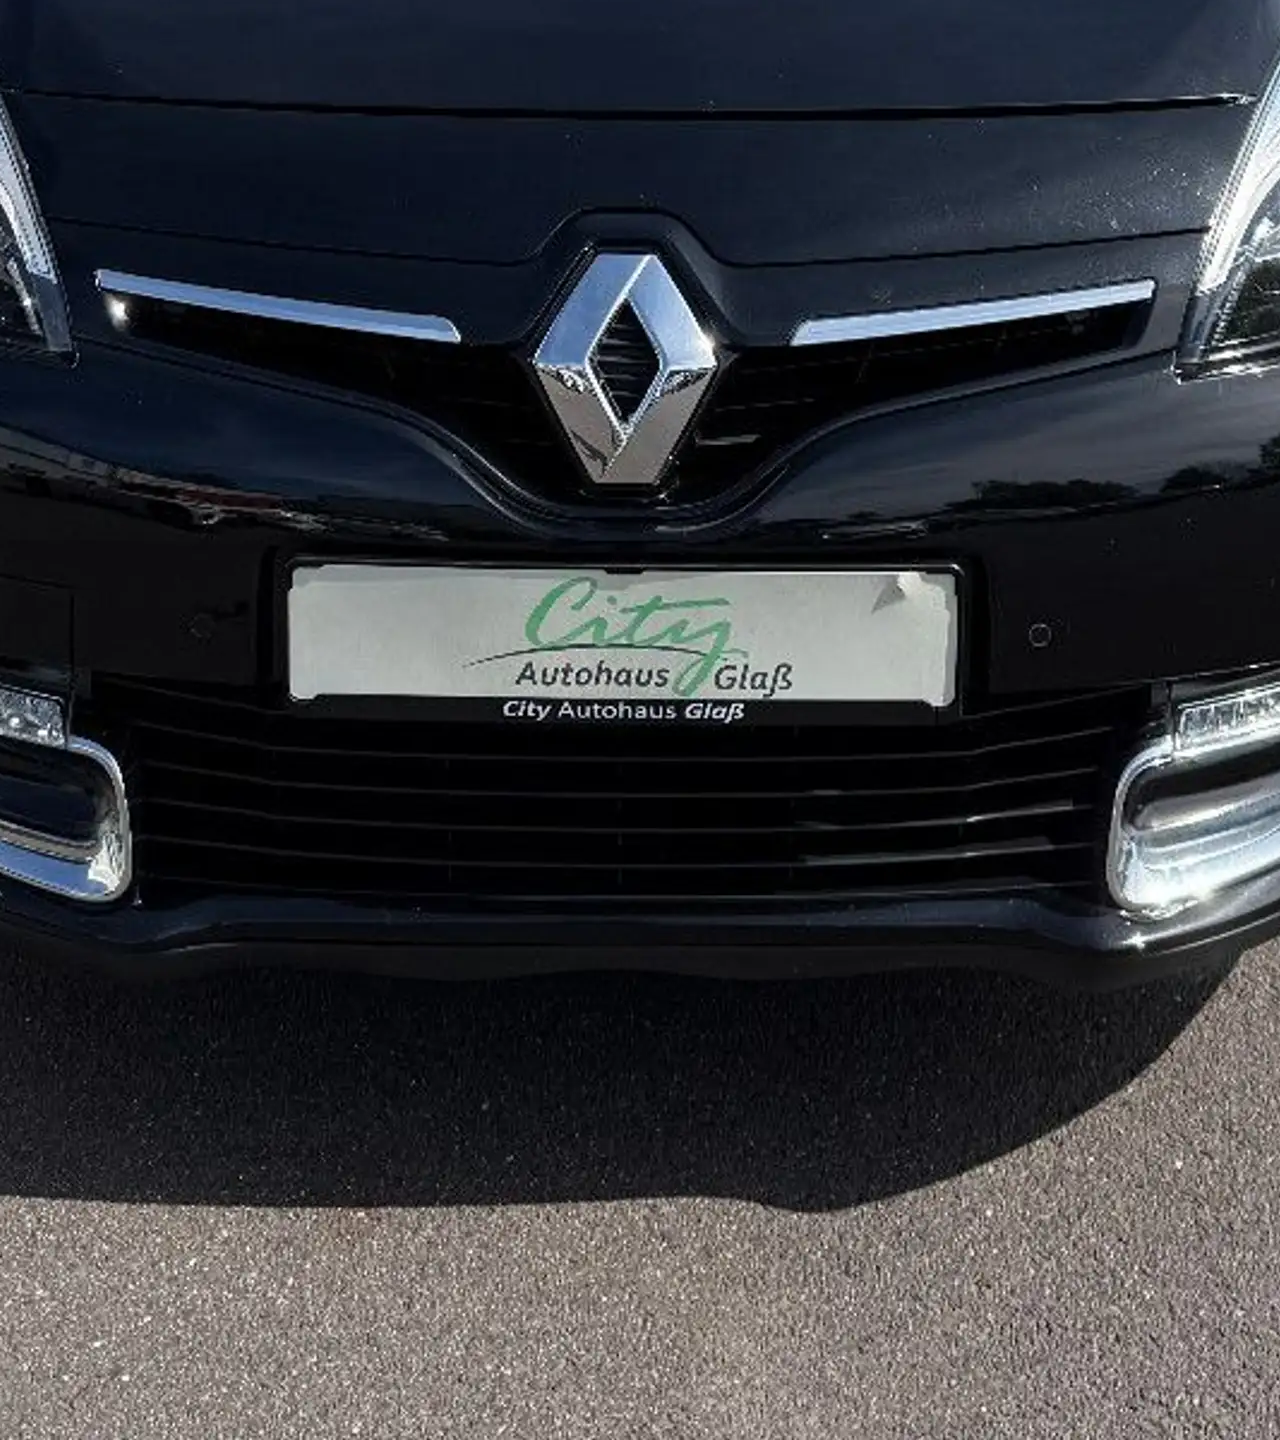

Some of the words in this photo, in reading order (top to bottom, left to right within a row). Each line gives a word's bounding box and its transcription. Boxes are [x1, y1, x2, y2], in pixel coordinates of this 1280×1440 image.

[525, 576, 749, 697] City
[515, 661, 670, 688] Autohaus
[714, 663, 793, 698] Glaß
[502, 700, 553, 720] City
[558, 700, 677, 719] Autohaus
[684, 703, 745, 724] Glaß
